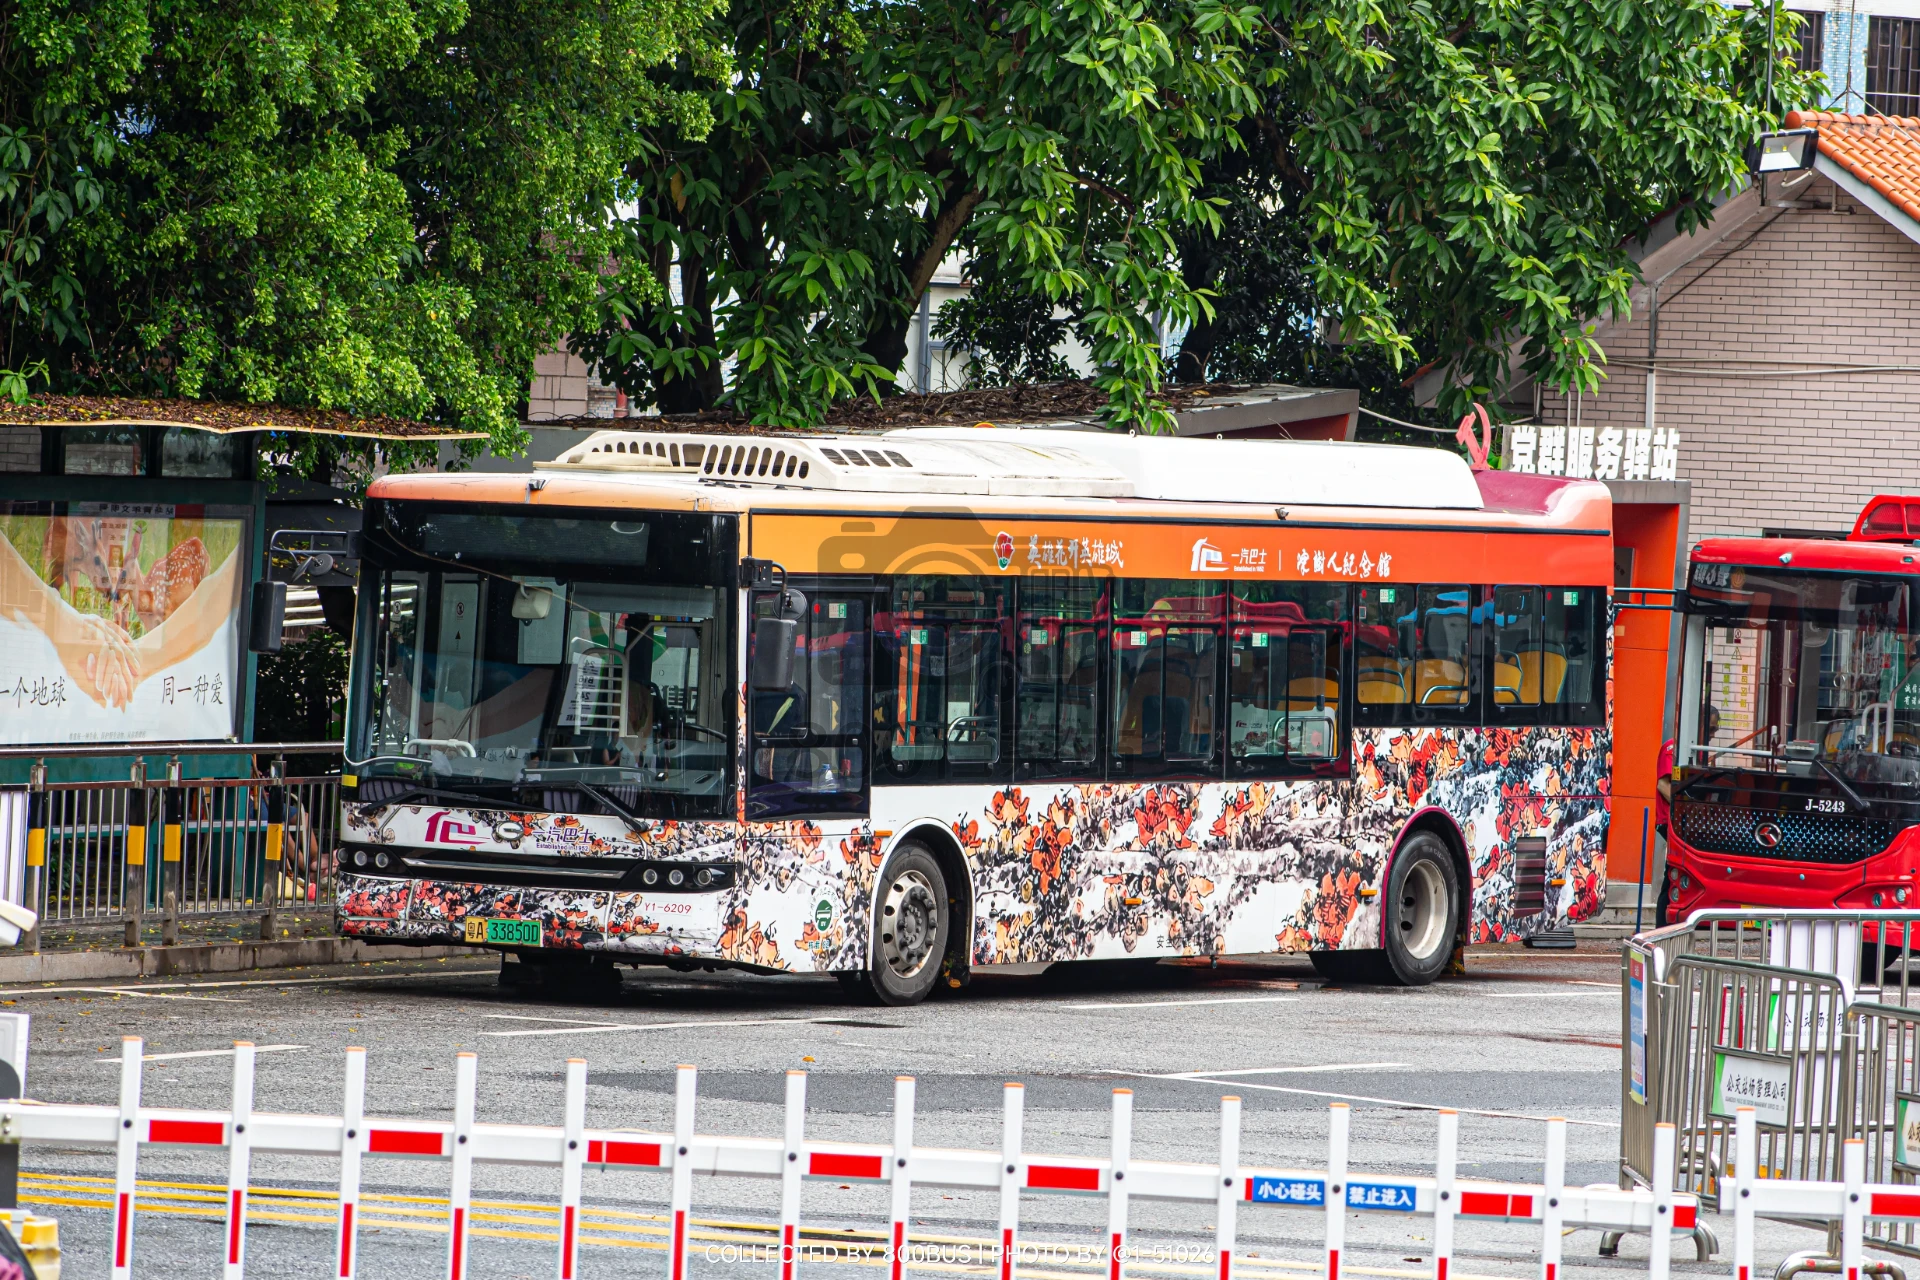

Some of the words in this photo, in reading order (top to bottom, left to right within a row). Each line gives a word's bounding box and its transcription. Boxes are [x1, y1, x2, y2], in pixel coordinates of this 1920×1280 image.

[1509, 426, 1680, 481] 党群服务驿站
[1027, 534, 1124, 569] 英雄花开英雄城
[1231, 548, 1267, 564] 一汽巴士
[162, 673, 224, 705] 同一种爱
[1804, 798, 1846, 813] J-5243
[532, 826, 594, 843] 一汽巴士
[644, 903, 692, 914] Y1-6209
[467, 922, 484, 939] 粤A
[491, 922, 538, 942] 33850D
[1726, 1073, 1787, 1102] 公交站场管理公司
[1258, 1180, 1322, 1202] 小心碰头
[1349, 1186, 1413, 1206] 禁止进入
